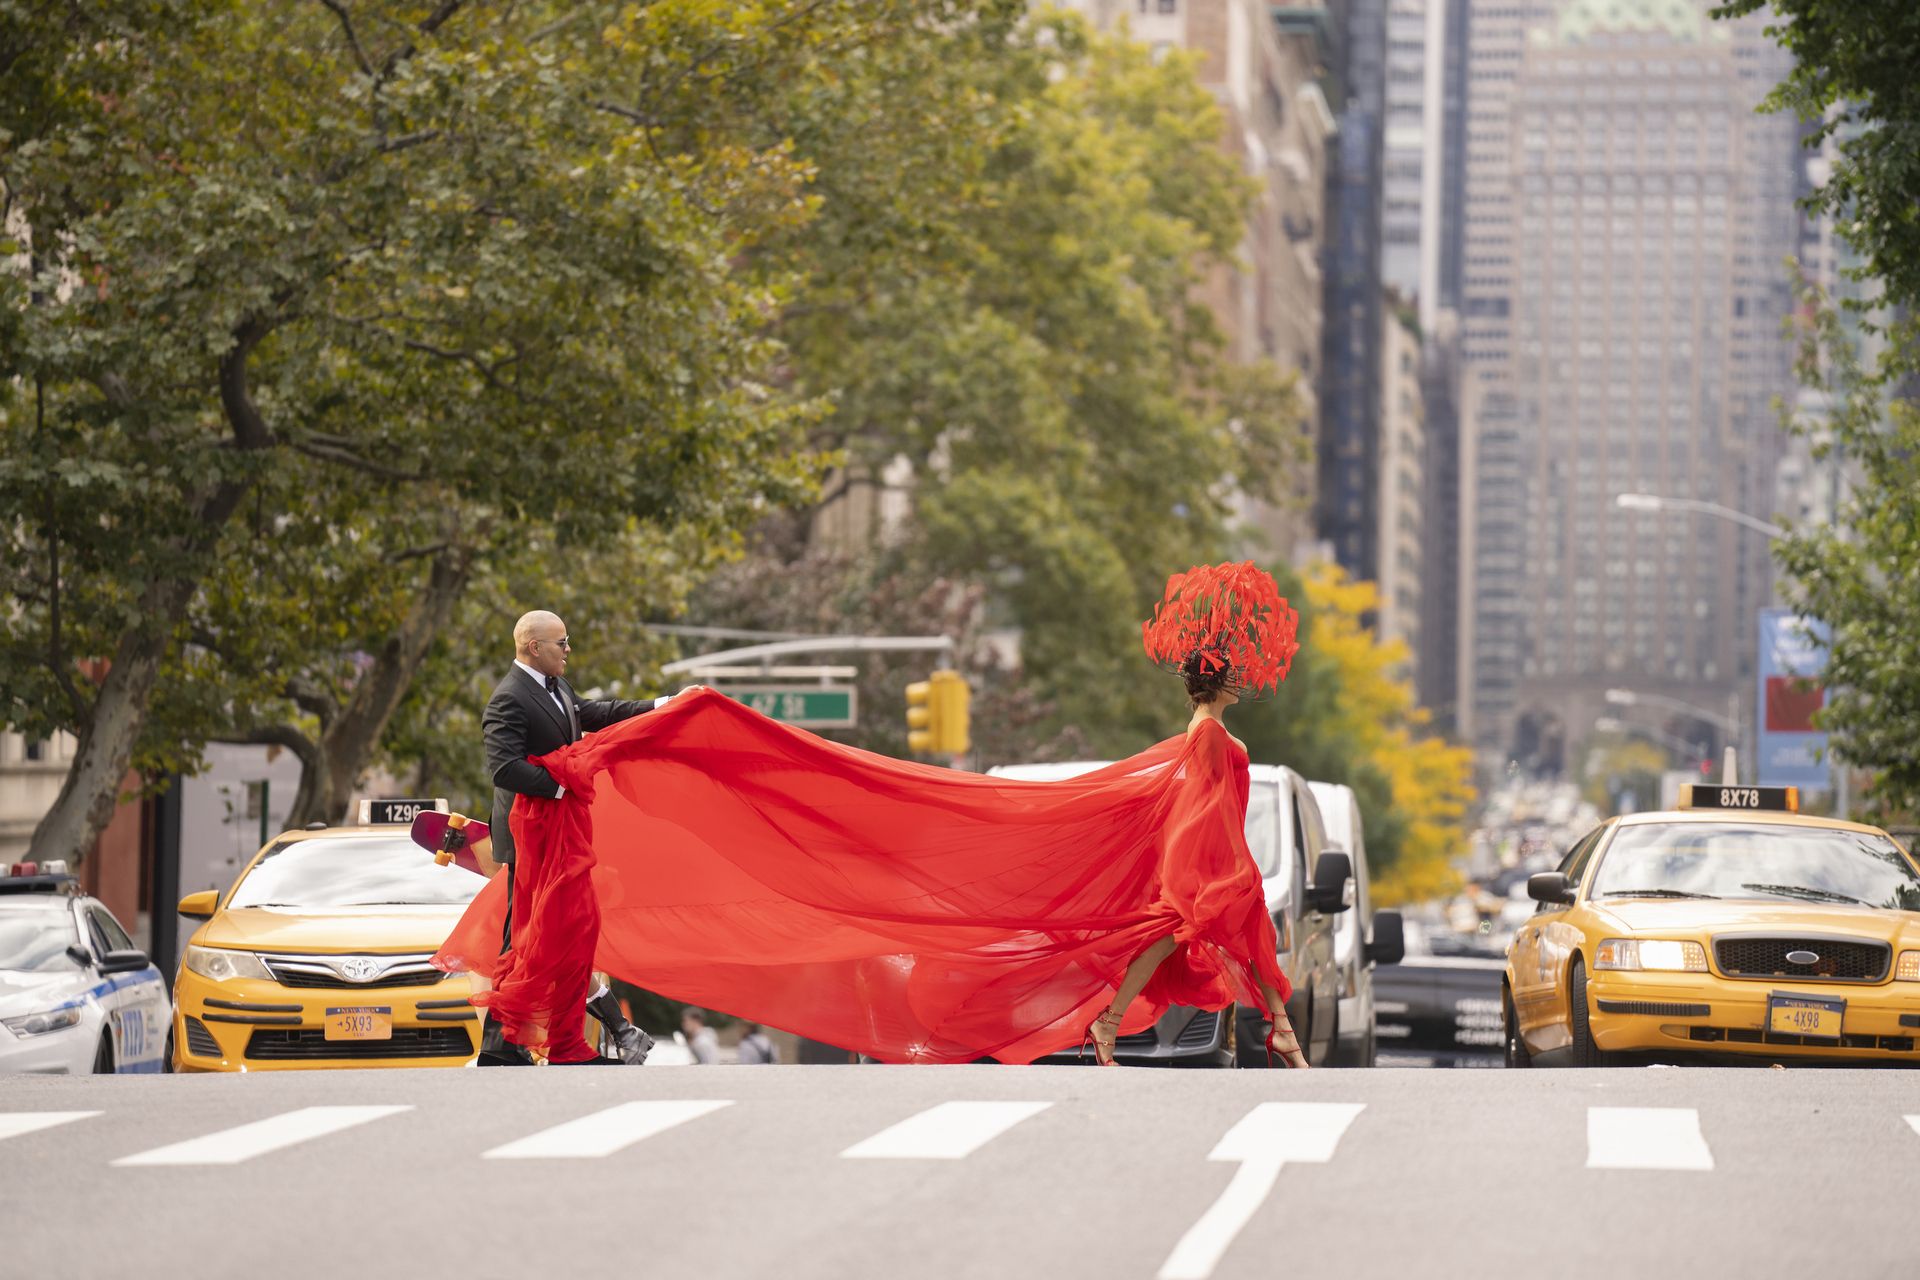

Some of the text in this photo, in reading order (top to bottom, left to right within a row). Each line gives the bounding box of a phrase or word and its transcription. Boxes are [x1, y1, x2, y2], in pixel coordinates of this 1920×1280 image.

[1720, 788, 1760, 808] 8X78
[345, 1015, 372, 1032] 5X93
[1794, 1010, 1820, 1029] 4X98
